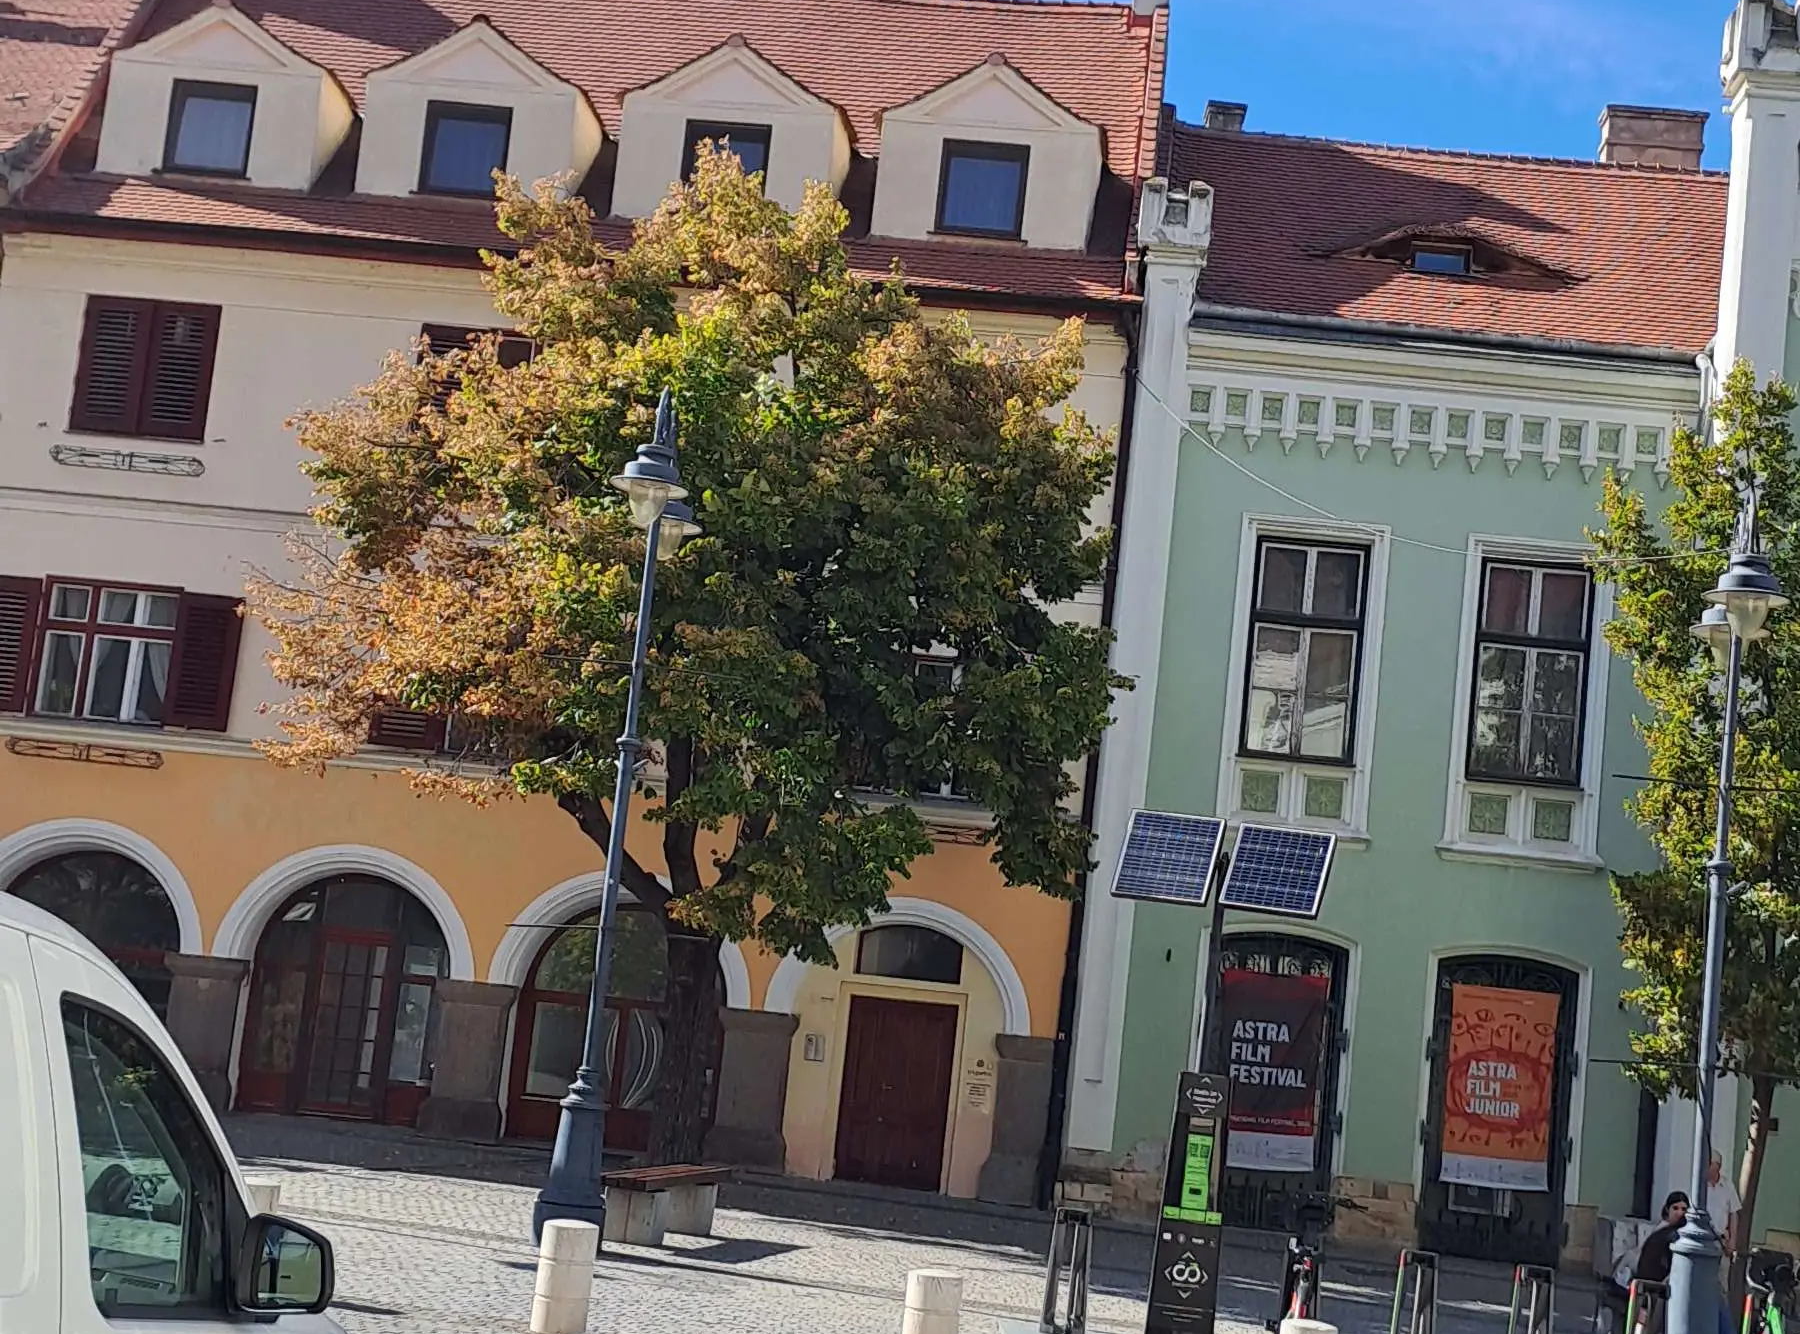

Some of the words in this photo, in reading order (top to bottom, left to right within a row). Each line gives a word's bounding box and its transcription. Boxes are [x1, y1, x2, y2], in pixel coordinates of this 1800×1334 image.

[1232, 1019, 1290, 1043] ASTRA
[1231, 1041, 1271, 1063] FILM
[1229, 1063, 1307, 1088] FESTIVAL
[1467, 1058, 1517, 1080] ASTRA
[1466, 1078, 1501, 1098] FILM
[1464, 1098, 1520, 1119] JUNIOR
